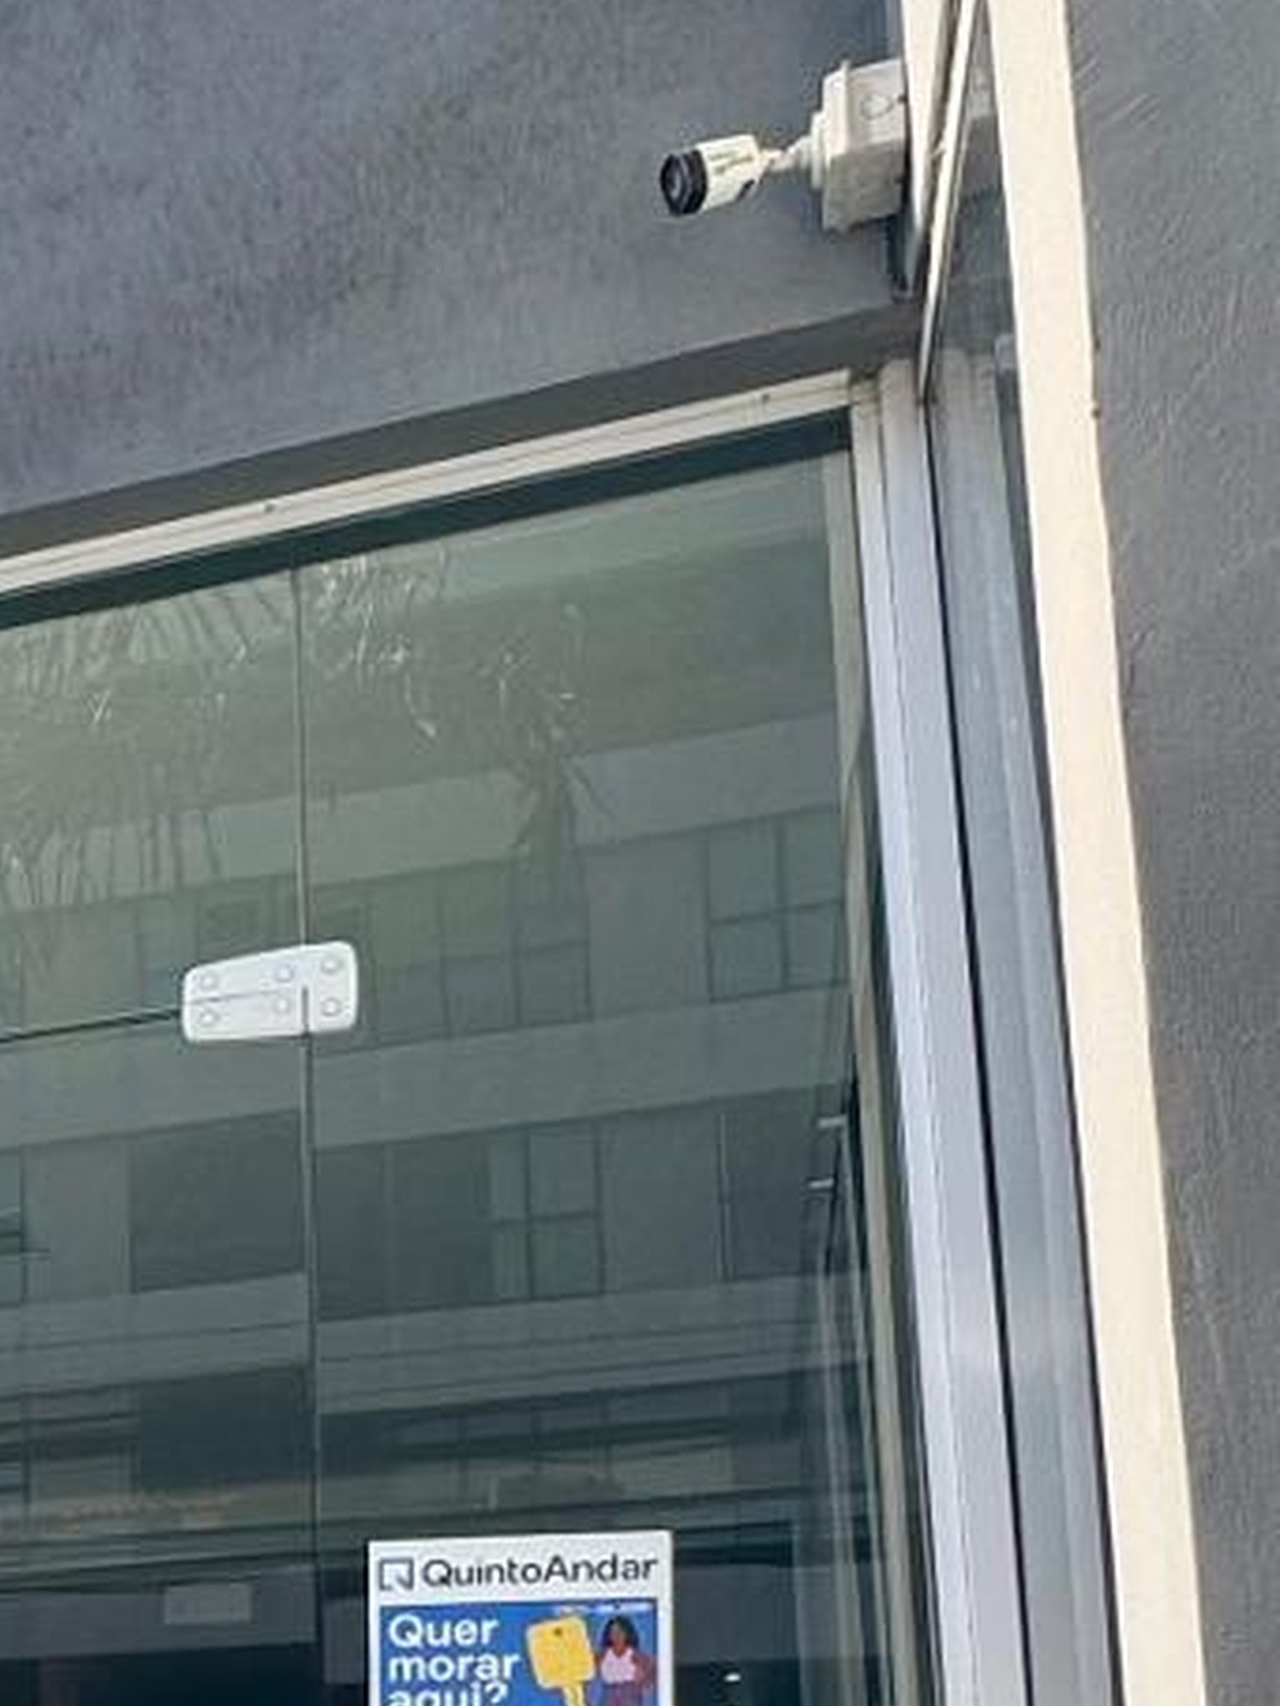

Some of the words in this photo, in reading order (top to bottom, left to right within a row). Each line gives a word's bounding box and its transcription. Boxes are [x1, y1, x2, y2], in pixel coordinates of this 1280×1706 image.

[421, 1554, 658, 1589] QuintoAndar
[387, 1614, 500, 1649] Quer
[387, 1652, 520, 1682] morar
